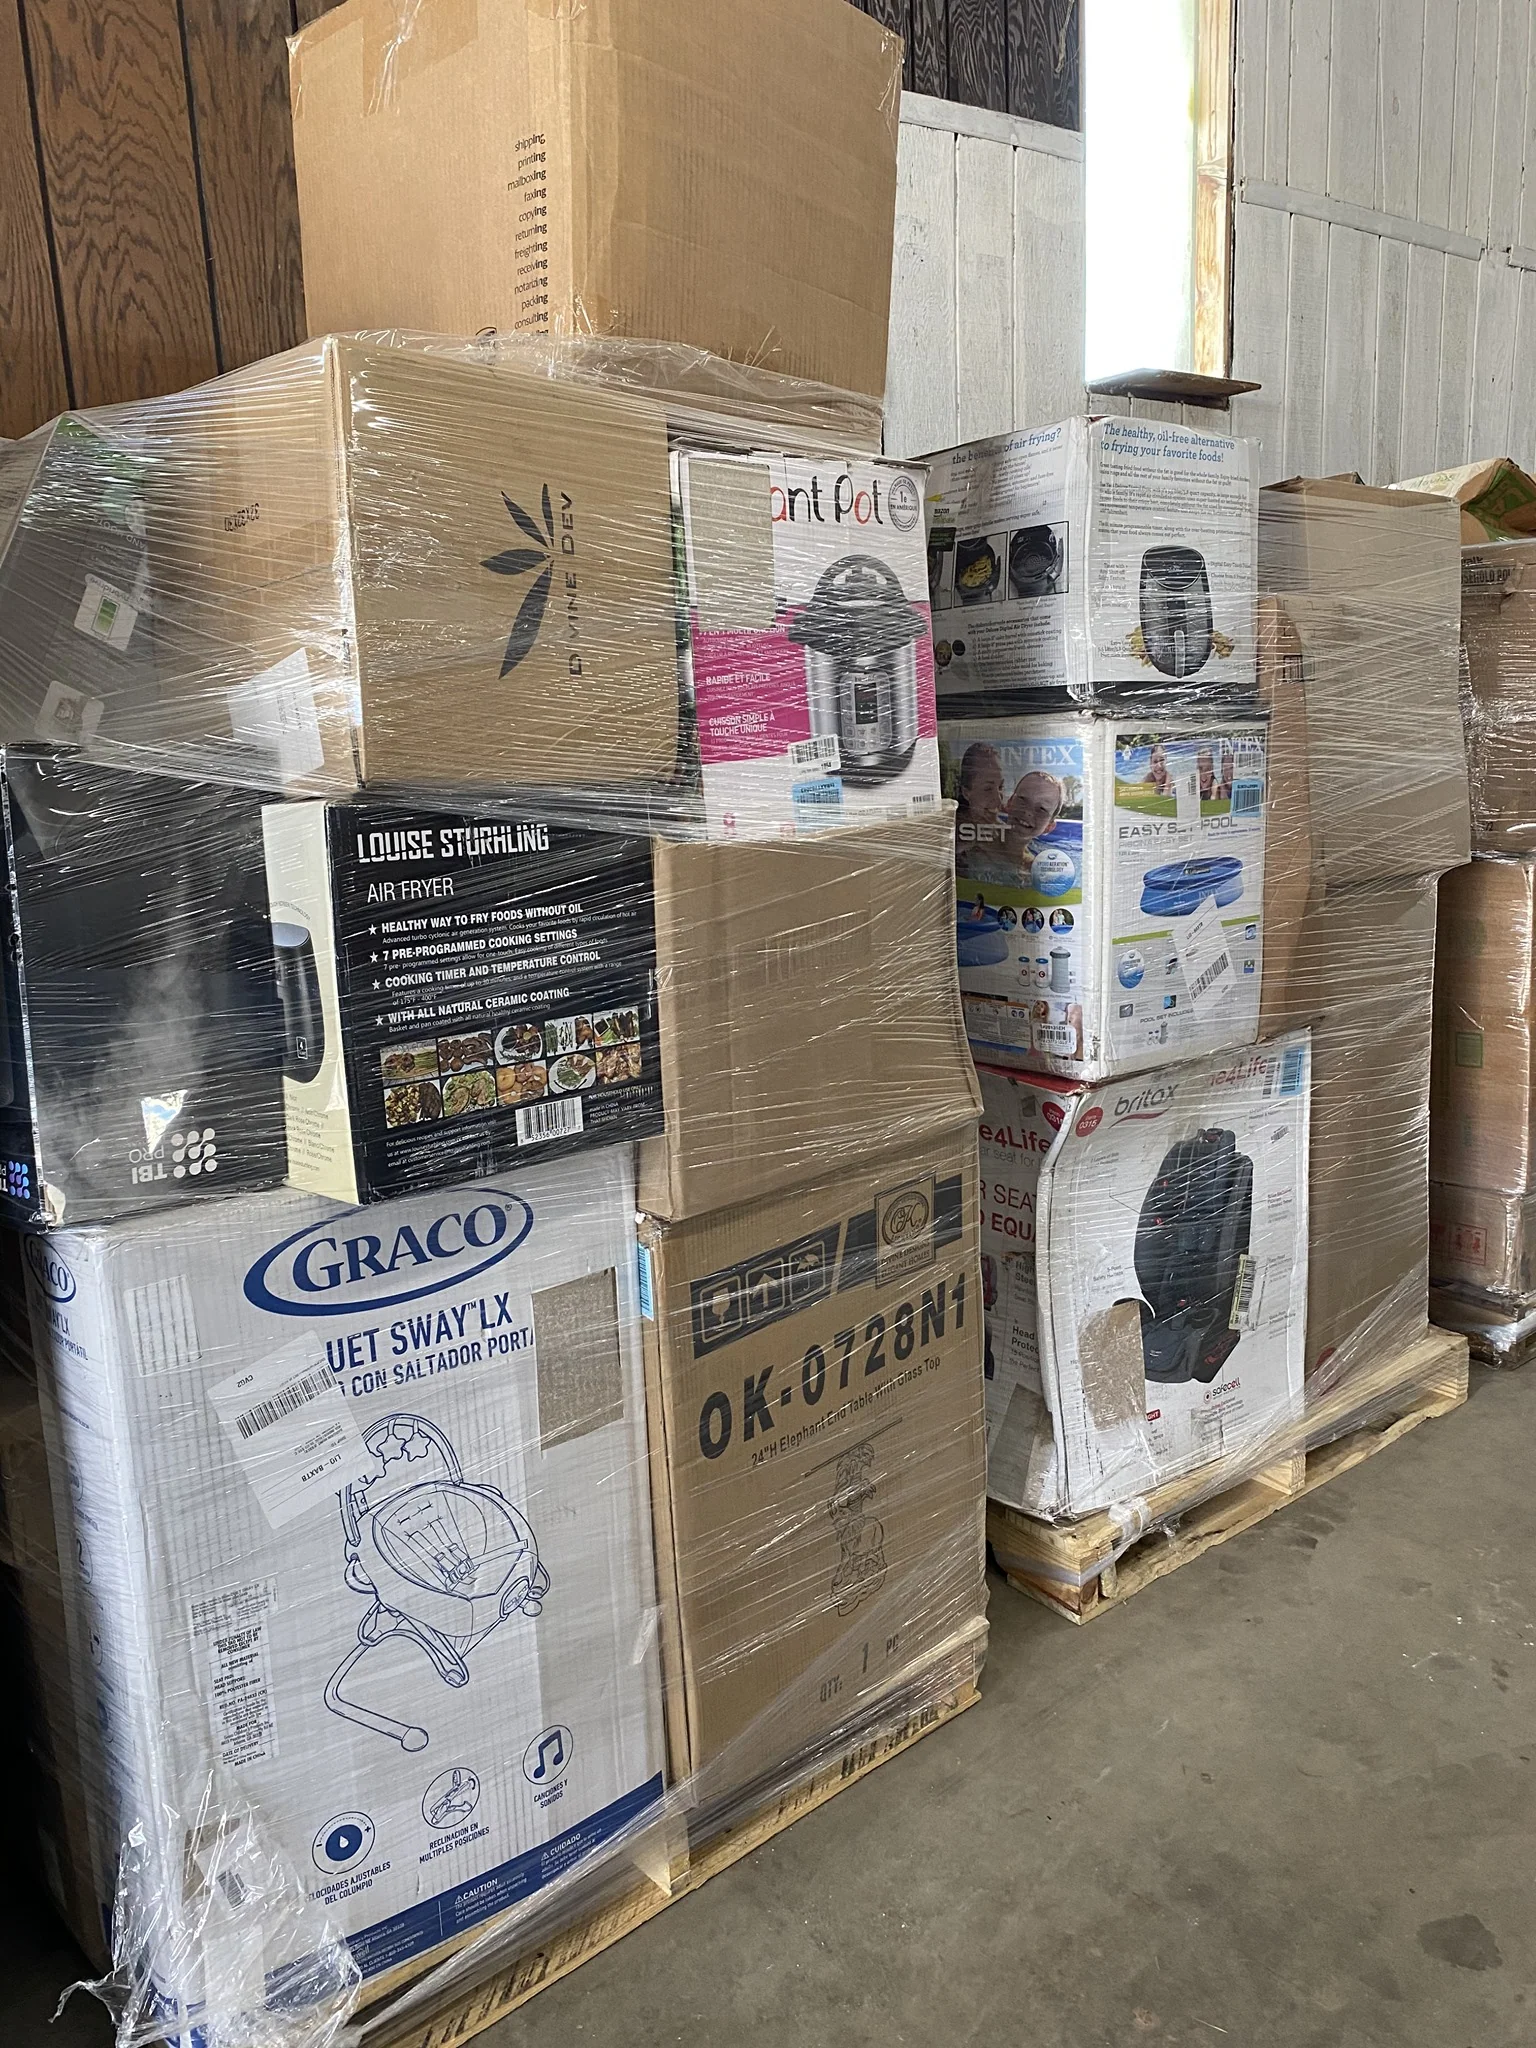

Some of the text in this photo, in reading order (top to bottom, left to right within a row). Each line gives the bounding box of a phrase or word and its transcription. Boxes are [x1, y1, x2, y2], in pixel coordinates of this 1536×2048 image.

[514, 133, 546, 152] shipping
[517, 151, 547, 171] printing
[507, 169, 547, 191] mailboxing
[524, 187, 547, 202] faxing
[518, 206, 547, 222] copying
[515, 223, 548, 241] returning
[514, 242, 548, 259] freighting
[516, 259, 548, 276] receiving
[514, 277, 548, 295] notarizing
[521, 294, 549, 312] packing
[514, 312, 549, 329] consulting
[952, 428, 1062, 464] the of air frying?
[1104, 423, 1235, 450] The healthy, oil-free alternative
[1100, 440, 1224, 463] to frying your favorite foods!
[834, 474, 884, 524] Pot
[561, 491, 582, 676] DVINE DEV
[745, 672, 771, 683] FACILE
[742, 713, 768, 725] SIMPLE
[710, 723, 768, 737] TOUCHE UNIQUE
[1000, 744, 1078, 766] INTEX
[958, 823, 1012, 842] SET
[1118, 823, 1163, 839] EASY
[1201, 816, 1239, 831] POOL
[357, 823, 550, 863] LOUISE STURHLING
[367, 877, 455, 903] AIR FRYER
[382, 903, 584, 934] HEALTHY WAY TO FRY FOODS WITHOUT OIL
[382, 913, 616, 945] Advanced turbo cyclonic generation Cooks your rapid circulation
[382, 928, 578, 961] 7 PRE-PROGRAMMED COOKING SETTINGS
[385, 950, 601, 988] COOKING TIMER AND TEMPERATURE CONTROL
[402, 952, 485, 969] programmed settings allow for
[391, 985, 444, 997] Features cooking
[421, 993, 437, 1002] 400°F
[388, 987, 570, 1024] WITH ALL NATURAL CERAMIC COATING
[388, 1003, 551, 1033] Basket and pan coated natural coating
[1114, 1083, 1179, 1117] britax
[590, 1110, 611, 1118] PRODUCT
[1079, 1118, 1098, 1129] 0315
[395, 1137, 416, 1146] delicious
[551, 1126, 570, 1137] 00727
[128, 1144, 165, 1164] PRO
[993, 1148, 1035, 1167] seat for
[131, 1162, 168, 1185] TBI
[292, 1202, 509, 1293] GRACO
[1014, 1260, 1035, 1274] High
[326, 1326, 380, 1374] UET
[480, 1292, 513, 1328] LX
[1011, 1325, 1035, 1341] Head
[351, 1367, 389, 1398] CON
[394, 1346, 483, 1391] SALTADOR
[699, 1272, 967, 1461] OK-0728N1
[1212, 1377, 1241, 1397] safecell
[750, 1355, 942, 1467] 24"H Elephant End Table With Glass Top
[301, 1464, 326, 1482] BAXTB
[239, 1652, 259, 1663] MATERIAL
[862, 1641, 870, 1674] 1
[886, 1632, 900, 1657] PC
[214, 1682, 226, 1691] HEAD
[214, 1682, 249, 1699] 100% POLYESTER
[240, 1740, 260, 1752] DELIVERY
[234, 1759, 247, 1767] MADE
[533, 1778, 569, 1804] CANCIONES Y
[540, 1790, 564, 1810] SONIDOS
[419, 1826, 491, 1865] MULTIPLES POSICIONES
[429, 1821, 480, 1850] RECLINACION EN
[550, 1833, 582, 1856] CUIDADO
[350, 1861, 391, 1885] AJUSTABLES
[324, 1878, 373, 1906] DEL COLUMPIO
[462, 1877, 499, 1900] CAUTION
[466, 1901, 480, 1912] should
